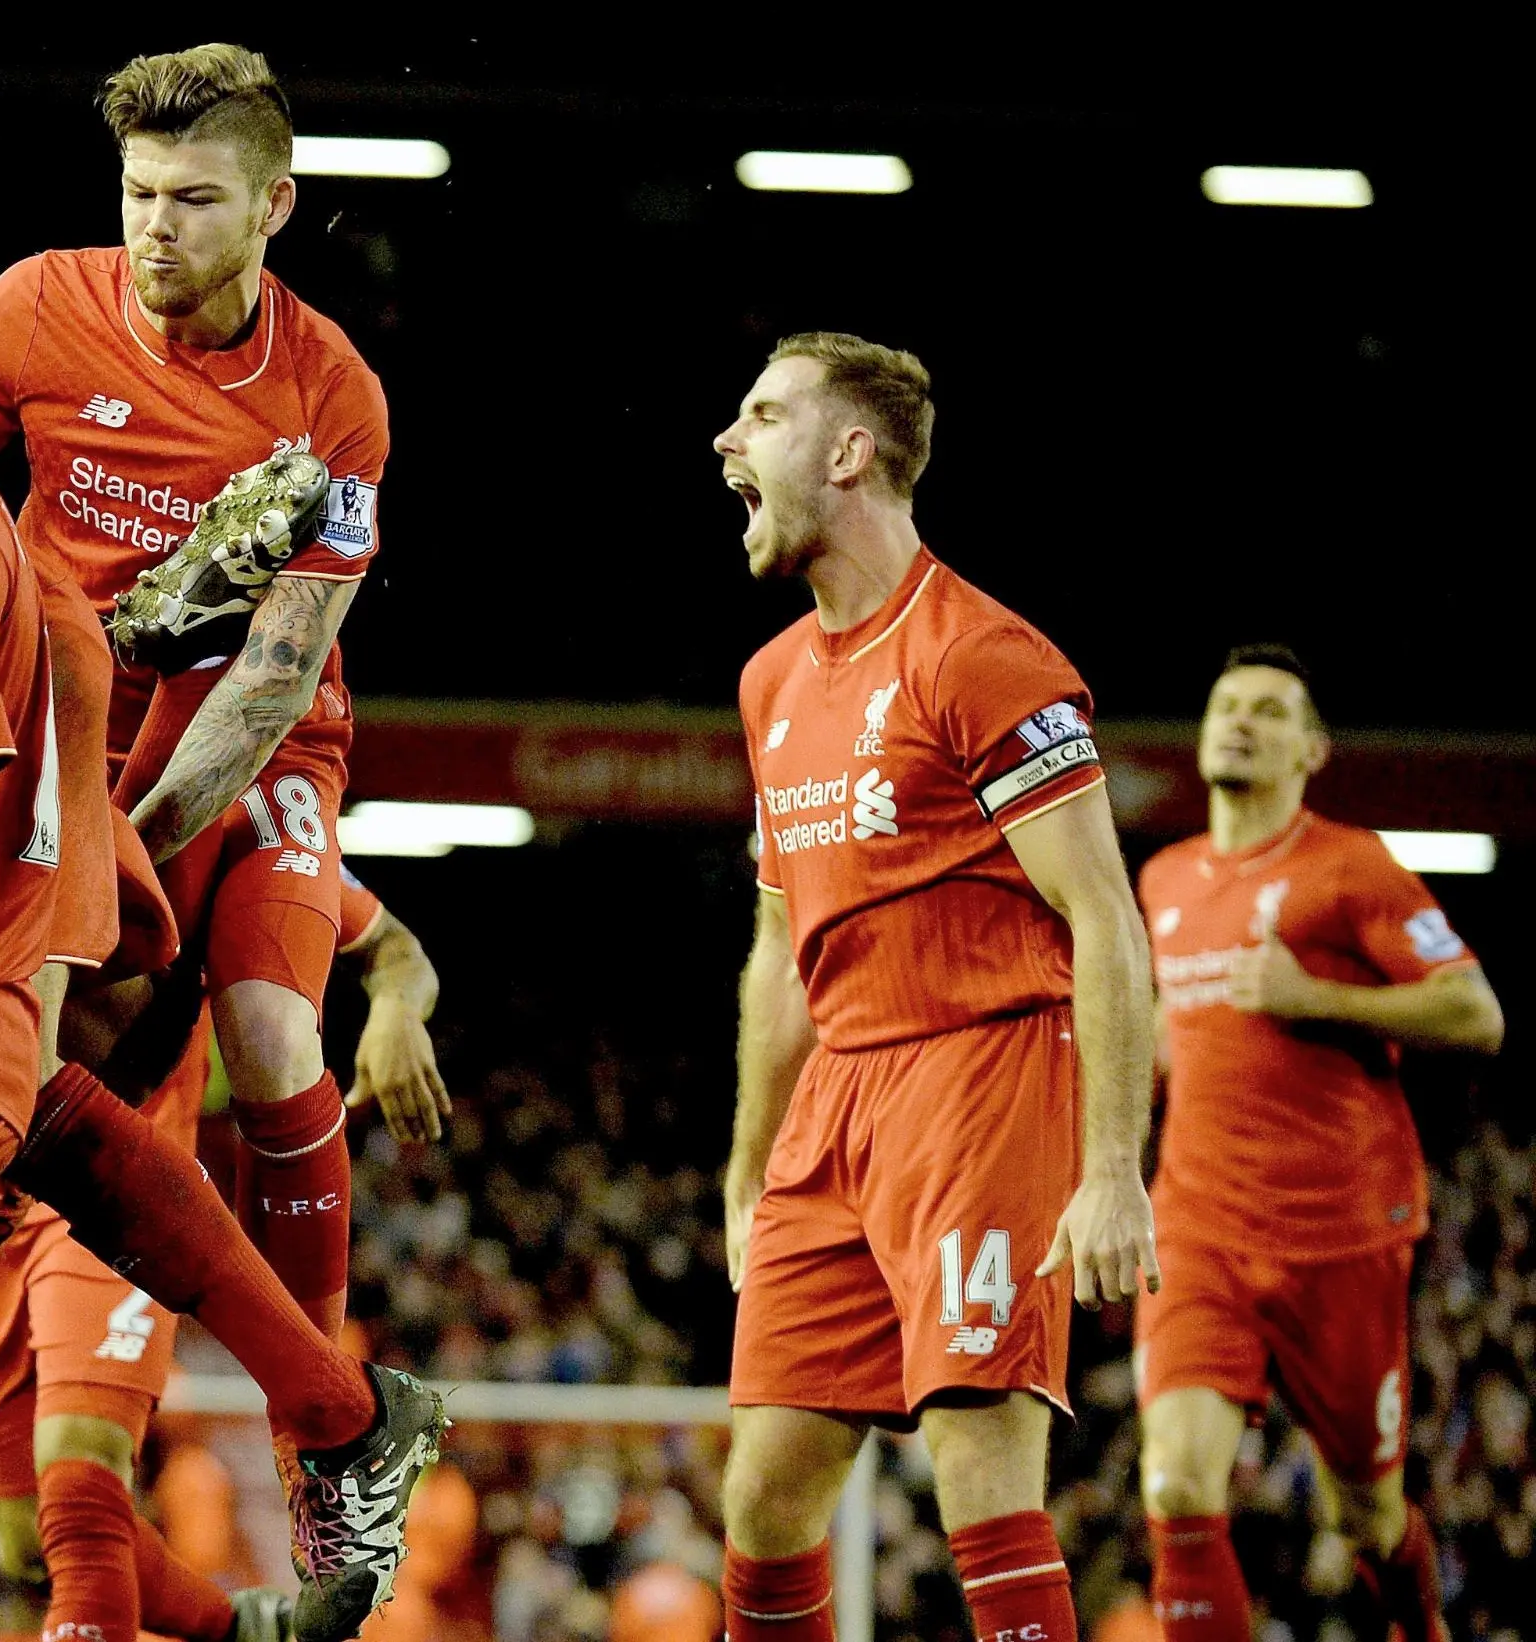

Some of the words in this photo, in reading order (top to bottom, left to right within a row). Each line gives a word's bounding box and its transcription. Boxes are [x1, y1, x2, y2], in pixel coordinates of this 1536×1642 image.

[59, 490, 187, 553] Charter
[239, 775, 327, 854] 18
[938, 1229, 1018, 1326] 14
